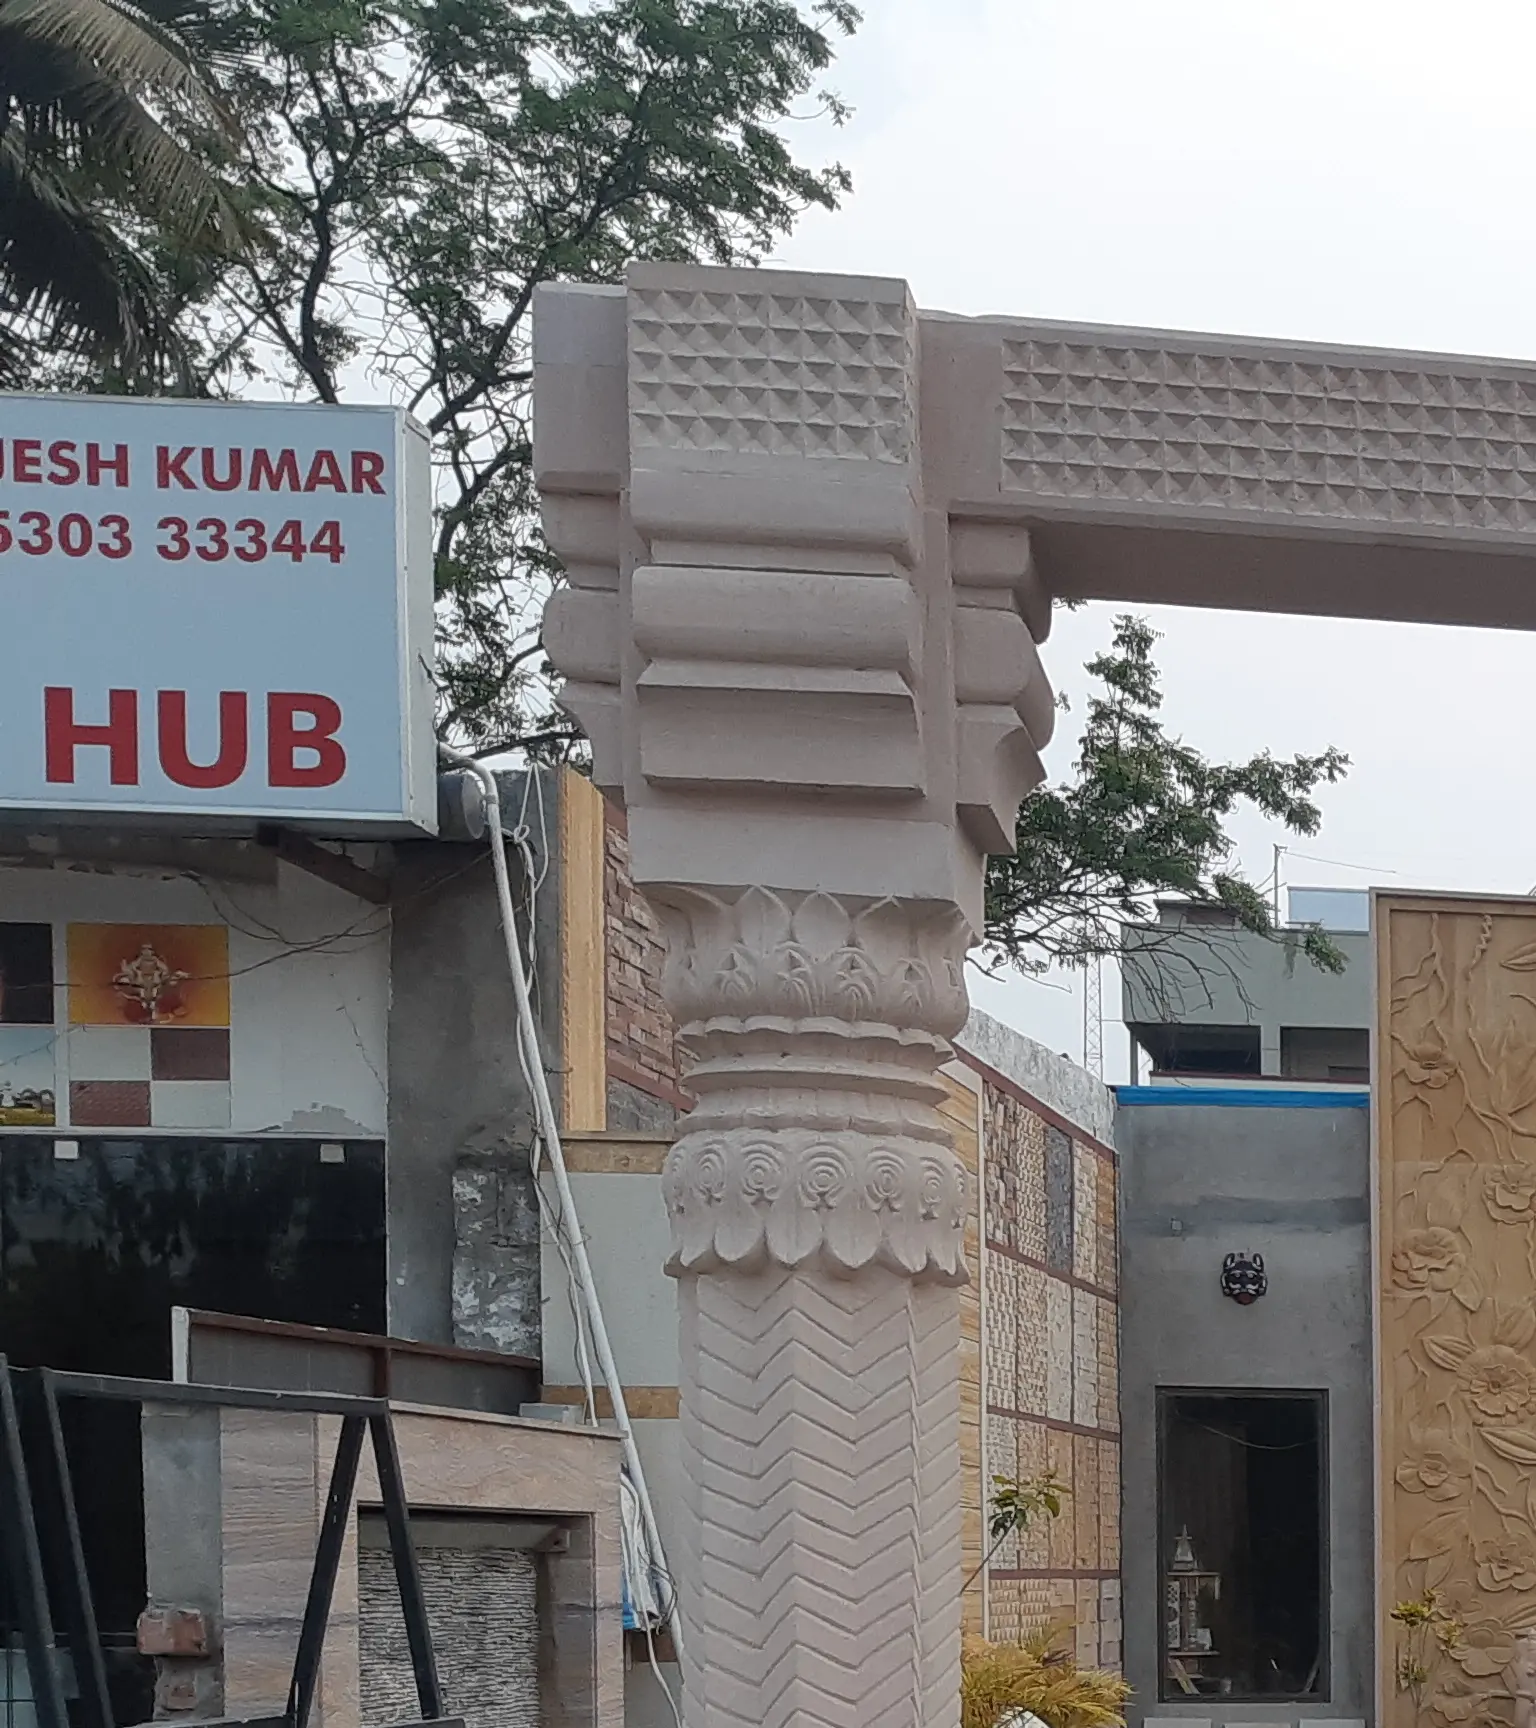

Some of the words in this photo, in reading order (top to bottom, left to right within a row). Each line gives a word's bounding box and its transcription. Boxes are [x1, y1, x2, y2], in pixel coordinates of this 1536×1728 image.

[0, 437, 129, 487] ESH
[156, 445, 387, 496] KUMAR
[155, 515, 346, 564] 33344
[44, 685, 347, 790] HUB
